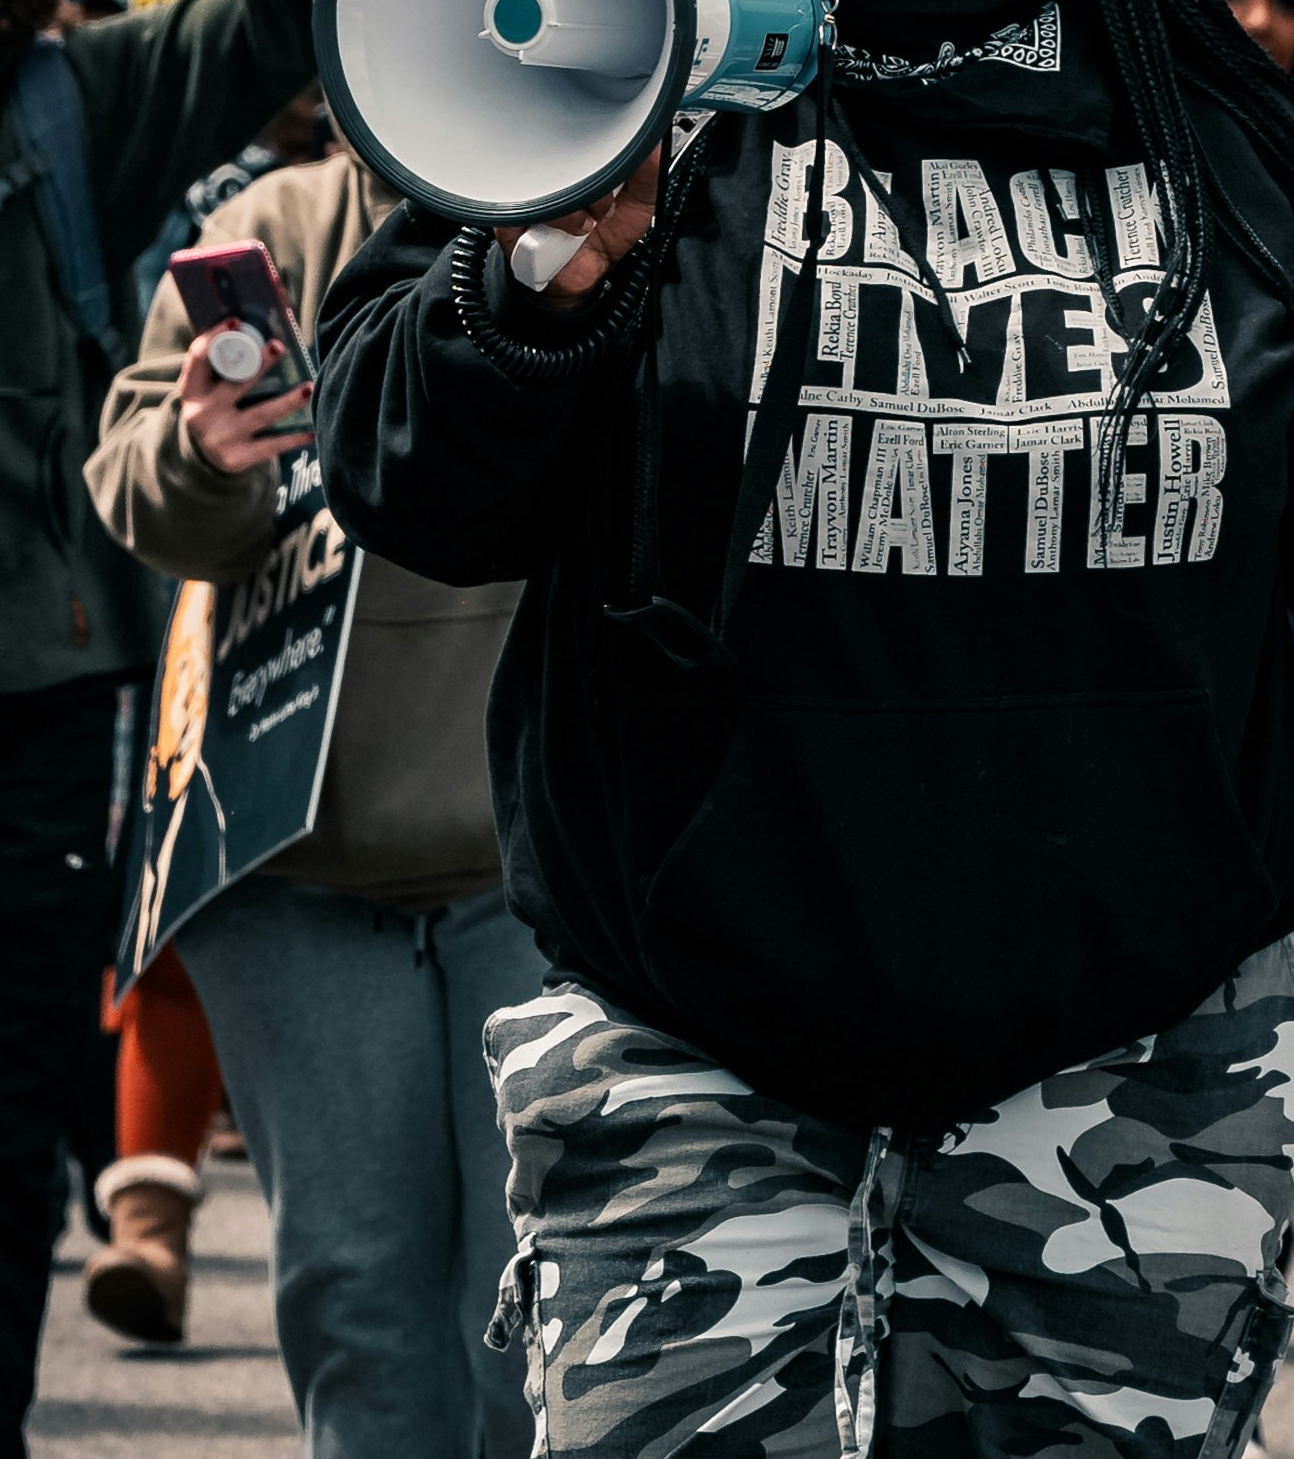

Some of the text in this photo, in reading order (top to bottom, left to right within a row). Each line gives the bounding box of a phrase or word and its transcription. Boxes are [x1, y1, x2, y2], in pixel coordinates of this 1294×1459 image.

[775, 153, 797, 192] Gray
[770, 193, 790, 246] Freddie
[928, 171, 943, 227] Martin
[1114, 169, 1142, 266] Terence Crutcher
[964, 287, 1001, 303] Walter
[821, 312, 842, 358] Rekia
[839, 320, 855, 361] Terence
[869, 395, 915, 412] Samuel
[1018, 401, 1053, 415] Clark
[902, 434, 925, 447] Ford
[1049, 434, 1083, 446] Clark
[821, 418, 842, 565] Trayvon Martin
[953, 455, 976, 575] Aiyana Jones
[1030, 450, 1050, 570] Samuel DuBose
[1157, 418, 1184, 563] Justin Howell
